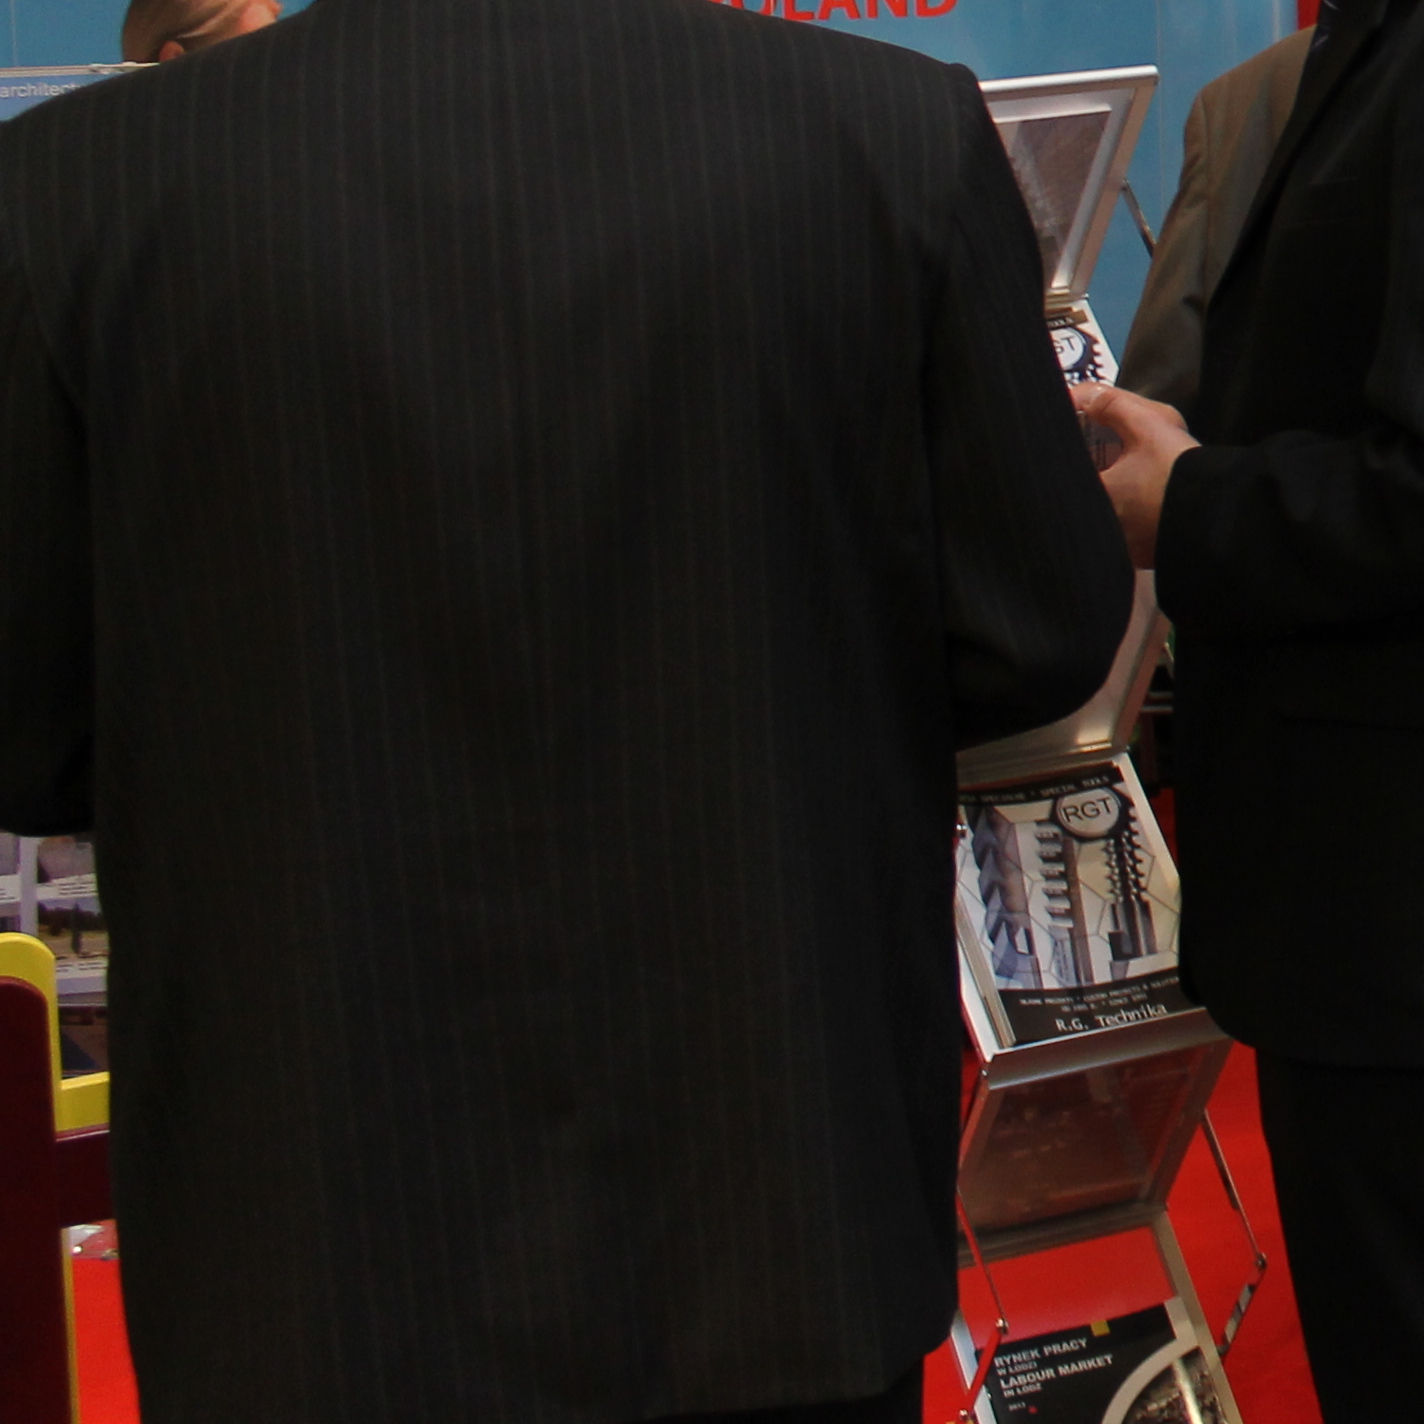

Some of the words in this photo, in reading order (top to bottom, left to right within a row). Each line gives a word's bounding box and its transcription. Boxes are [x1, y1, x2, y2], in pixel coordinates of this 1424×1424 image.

[1061, 795, 1112, 824] RGT
[1055, 1016, 1090, 1032] R.G.
[1094, 1003, 1168, 1028] Technika
[994, 1347, 1042, 1367] RYNEK
[1043, 1337, 1088, 1356] PRACY
[1000, 1367, 1057, 1390] LABOUR
[1057, 1353, 1114, 1377] MARKET
